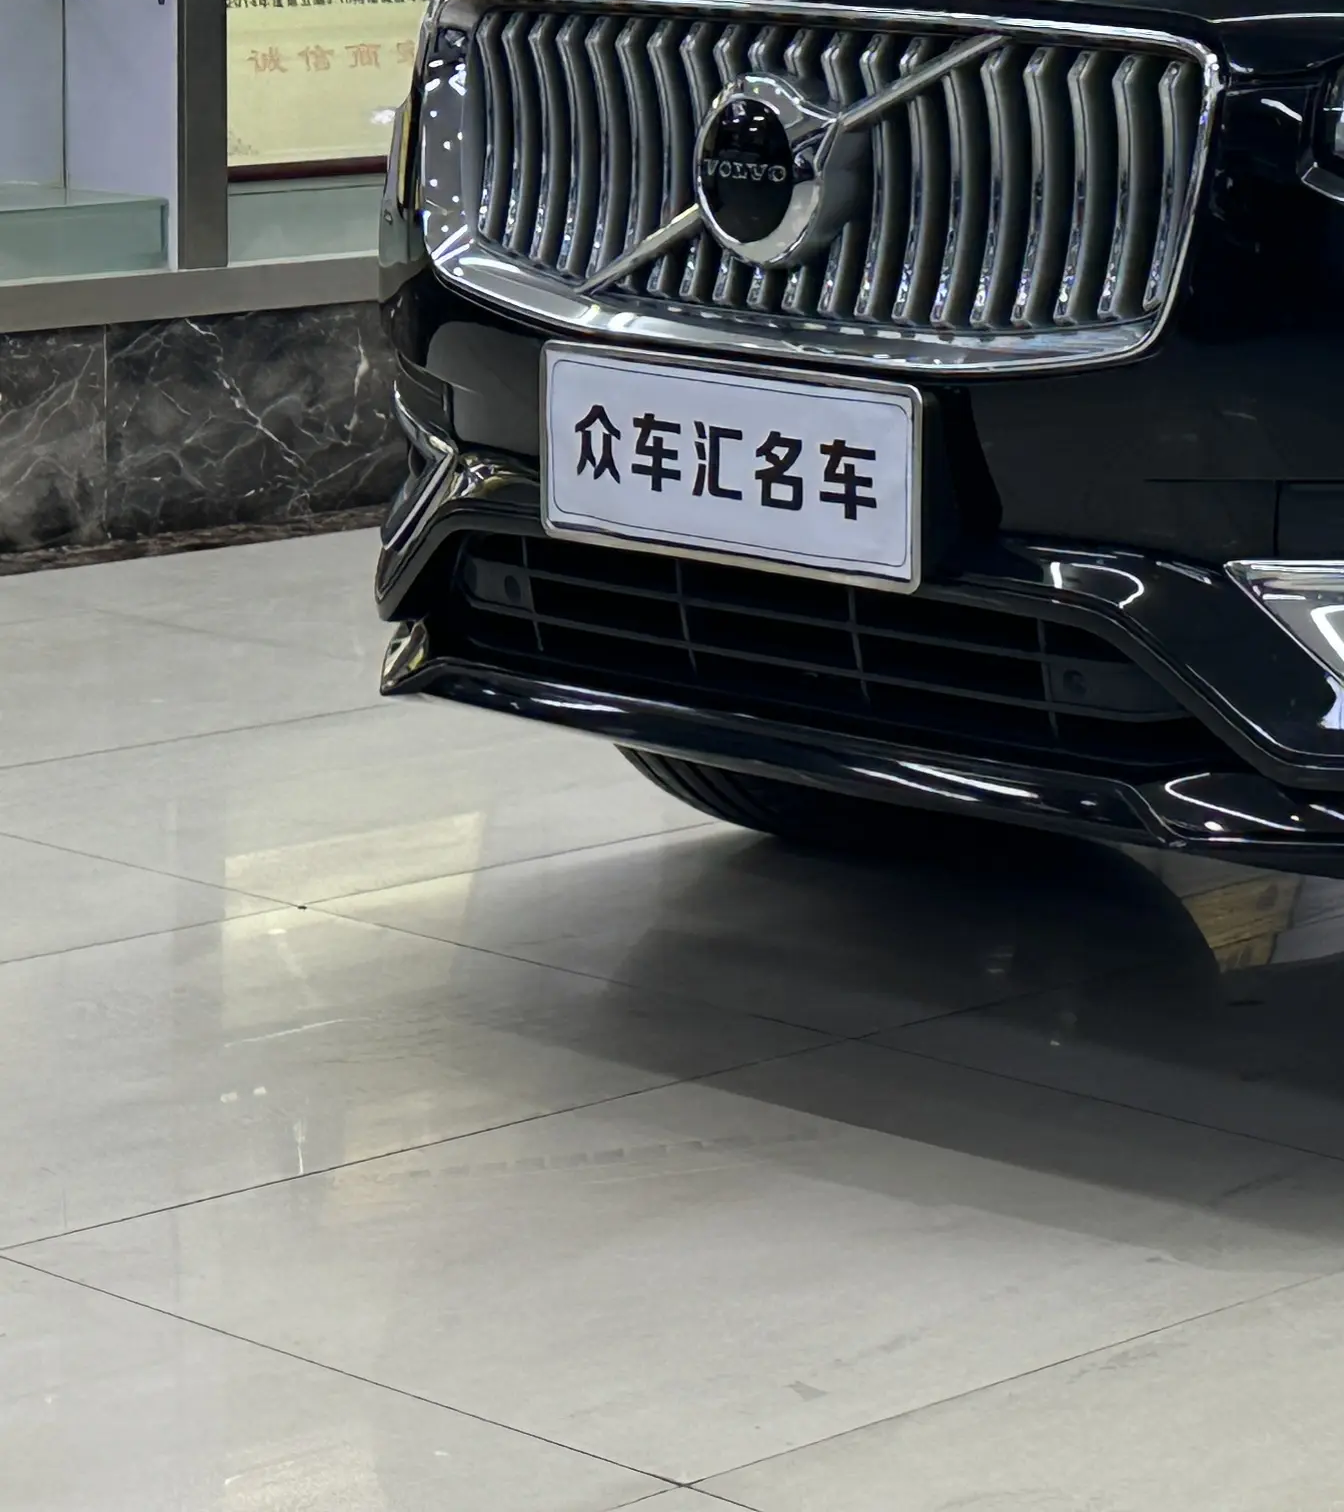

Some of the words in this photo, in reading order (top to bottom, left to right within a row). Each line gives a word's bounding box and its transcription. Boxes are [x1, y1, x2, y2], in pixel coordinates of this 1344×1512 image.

[703, 158, 787, 183] VOLVO
[574, 403, 879, 522] 众车汇名车
